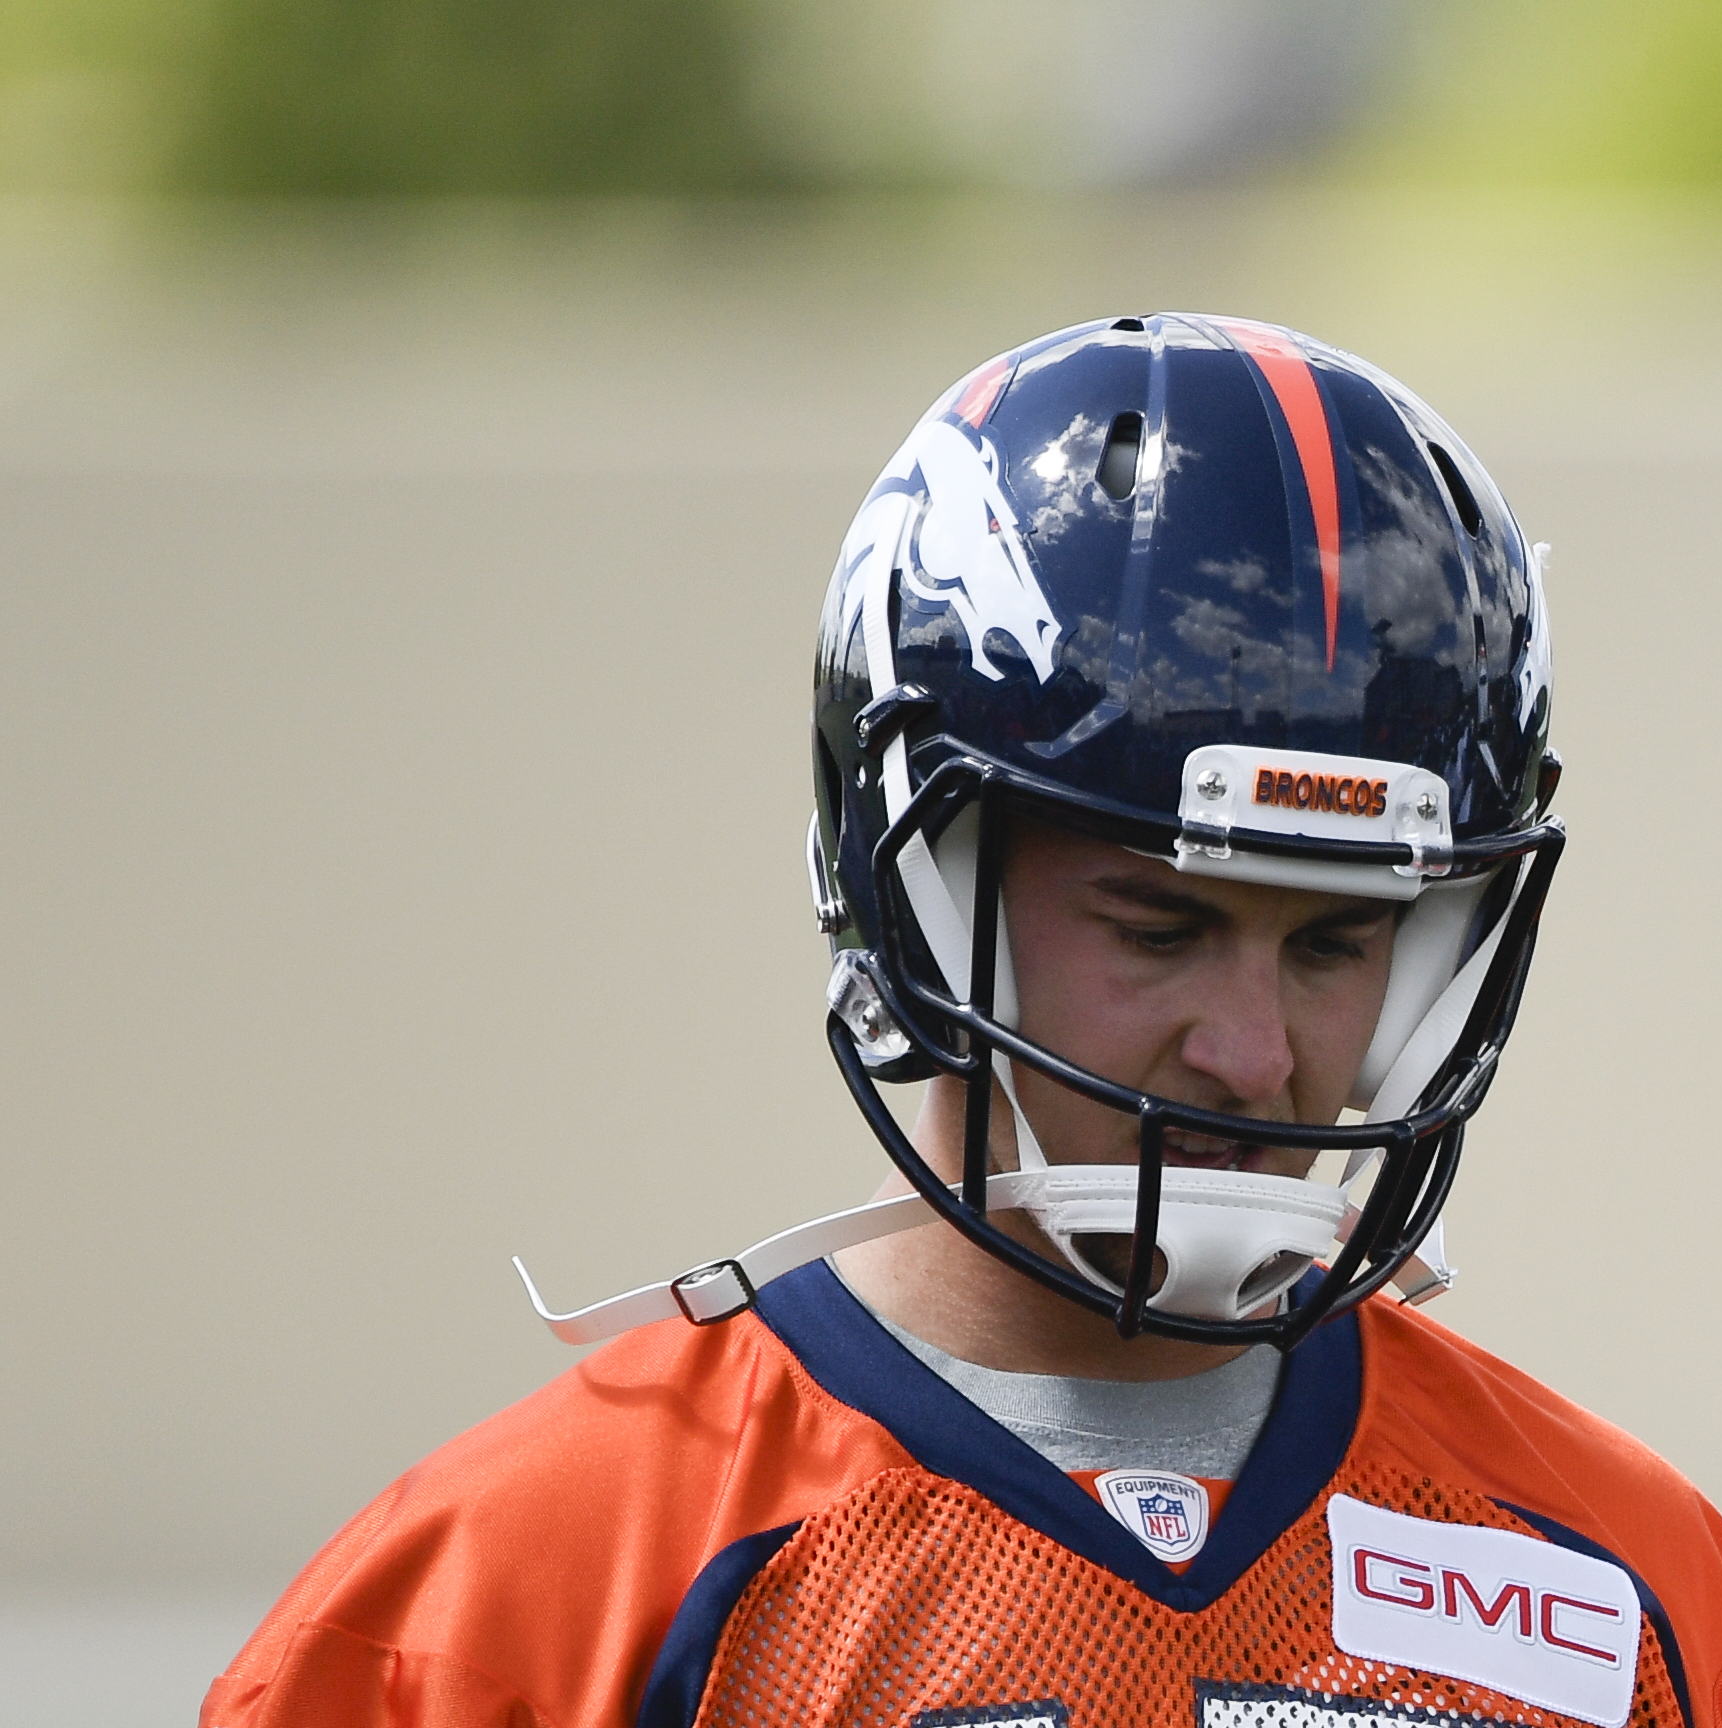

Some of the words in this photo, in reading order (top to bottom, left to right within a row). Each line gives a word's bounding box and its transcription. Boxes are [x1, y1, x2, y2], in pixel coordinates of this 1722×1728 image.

[1252, 765, 1388, 817] BRONCOS
[1115, 1480, 1196, 1501] EQUIPMENT
[1147, 1514, 1187, 1541] NFL
[1352, 1547, 1620, 1664] GMC
